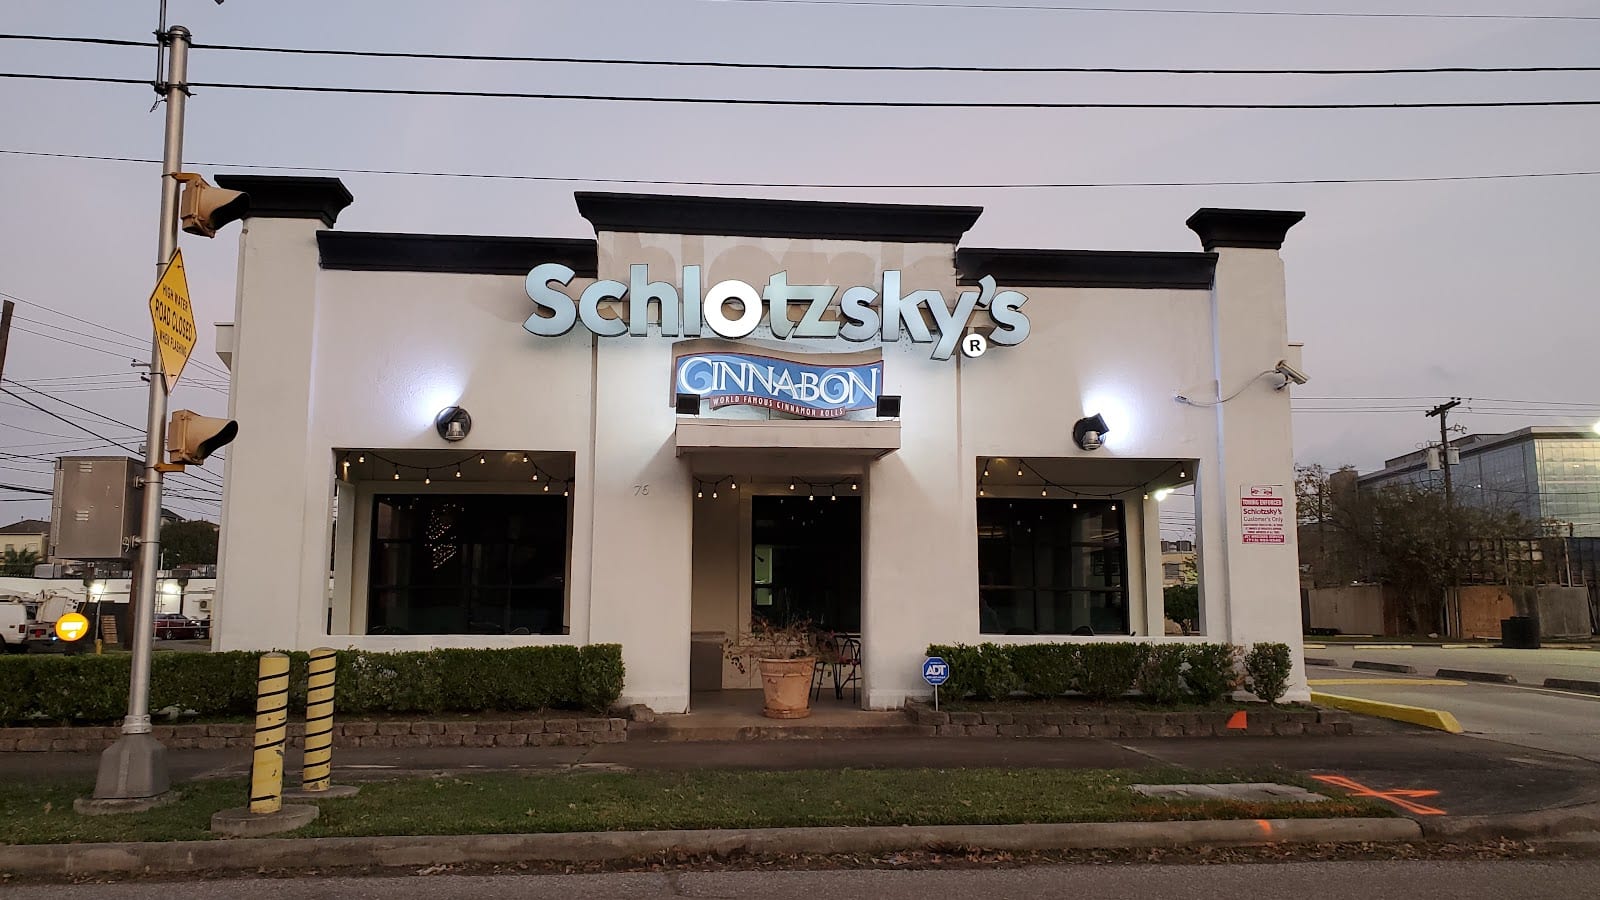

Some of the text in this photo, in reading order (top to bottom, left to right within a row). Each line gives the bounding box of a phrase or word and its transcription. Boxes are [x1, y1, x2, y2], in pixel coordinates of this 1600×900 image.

[162, 283, 188, 311] HIGH WATER
[155, 298, 192, 342] ROAD CLOSED
[522, 263, 1031, 361] Schlotzsky's
[160, 329, 171, 348] WHEN
[680, 356, 878, 404] CINNABON
[713, 396, 843, 417] WORLD FAMOUS CINNAMON ROLLS
[1243, 508, 1282, 516] Schlotzsky's
[925, 665, 947, 676] ADT
